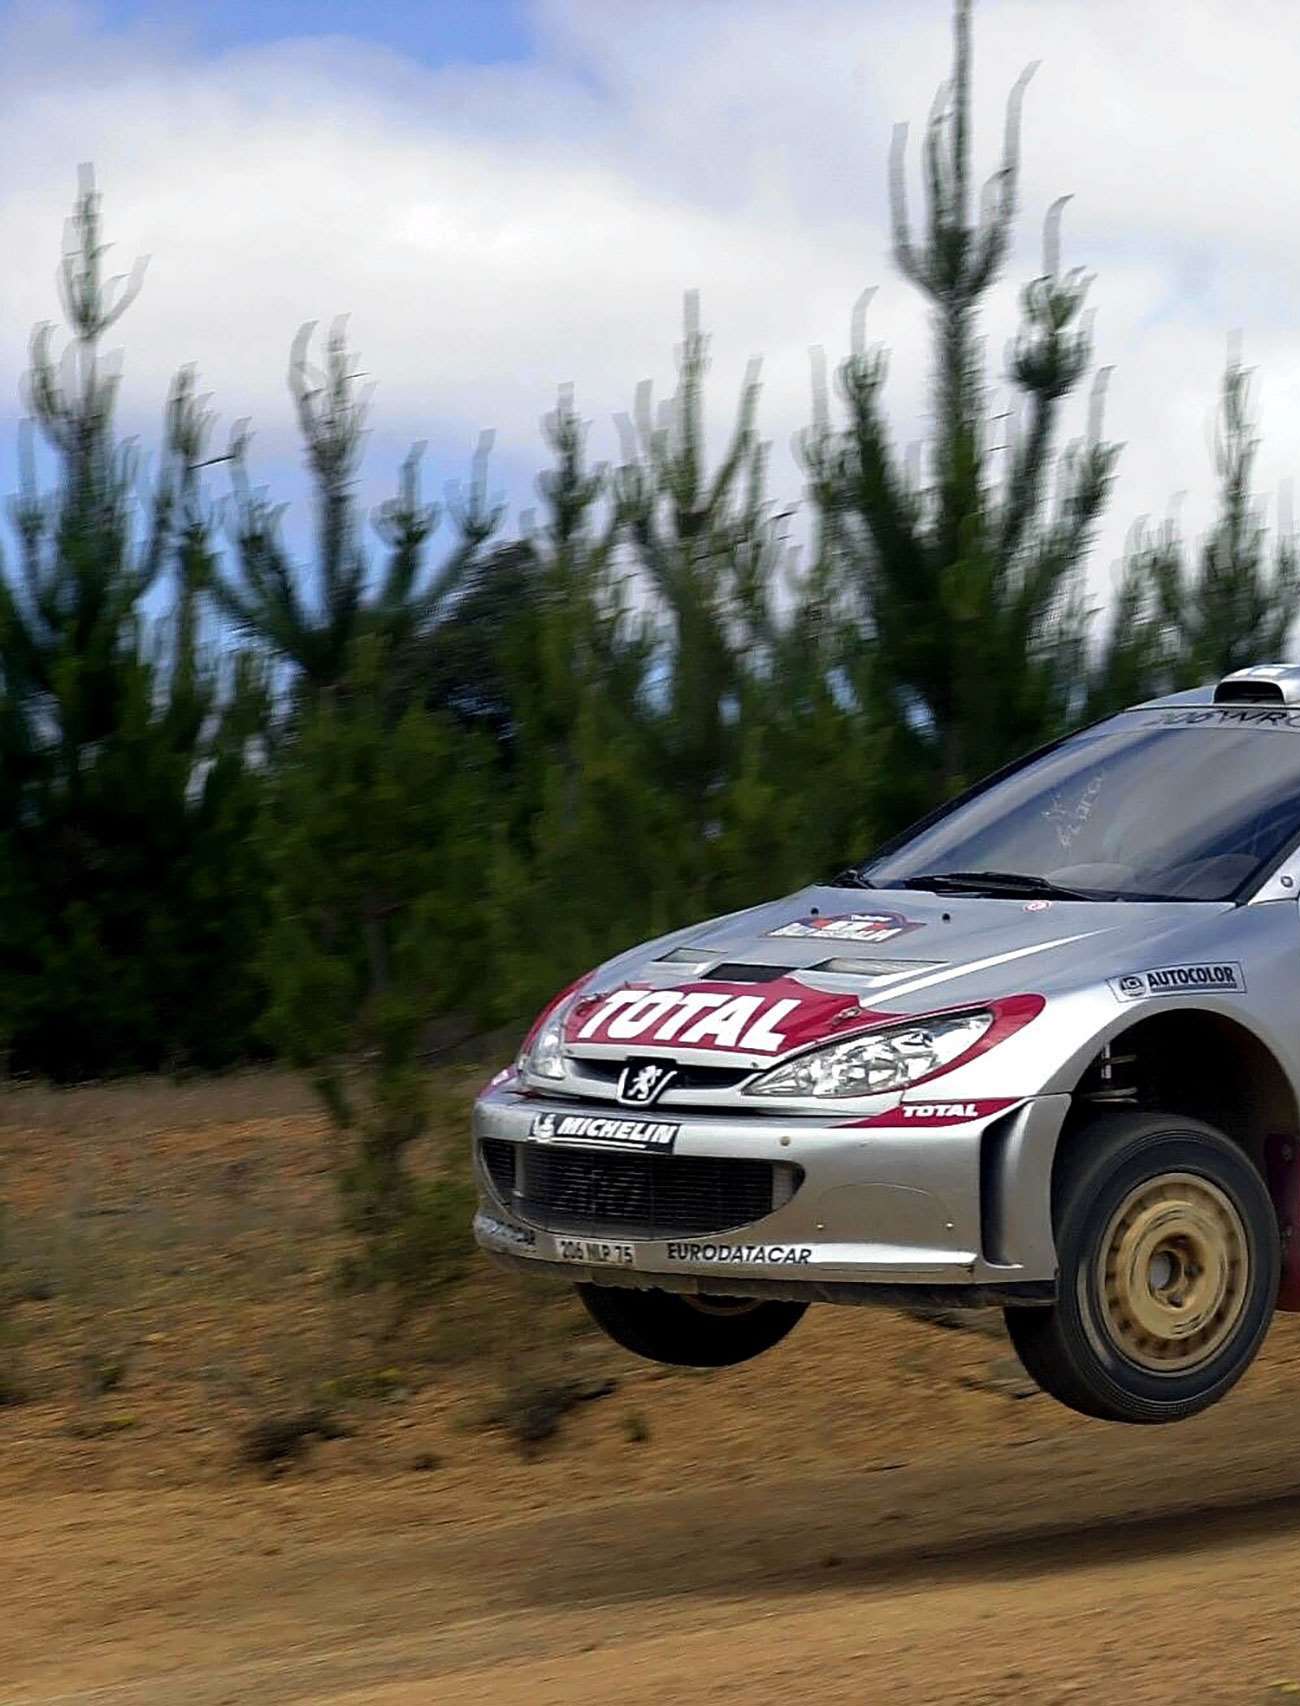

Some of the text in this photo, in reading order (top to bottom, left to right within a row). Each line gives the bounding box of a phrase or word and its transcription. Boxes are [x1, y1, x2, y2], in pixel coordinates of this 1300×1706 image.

[1146, 966, 1237, 988] AUTOCOLOR
[577, 989, 802, 1051] TOTAL
[902, 1103, 978, 1118] TOTAL
[556, 1116, 678, 1144] MICHELIN
[666, 1242, 812, 1265] EURODATACAR
